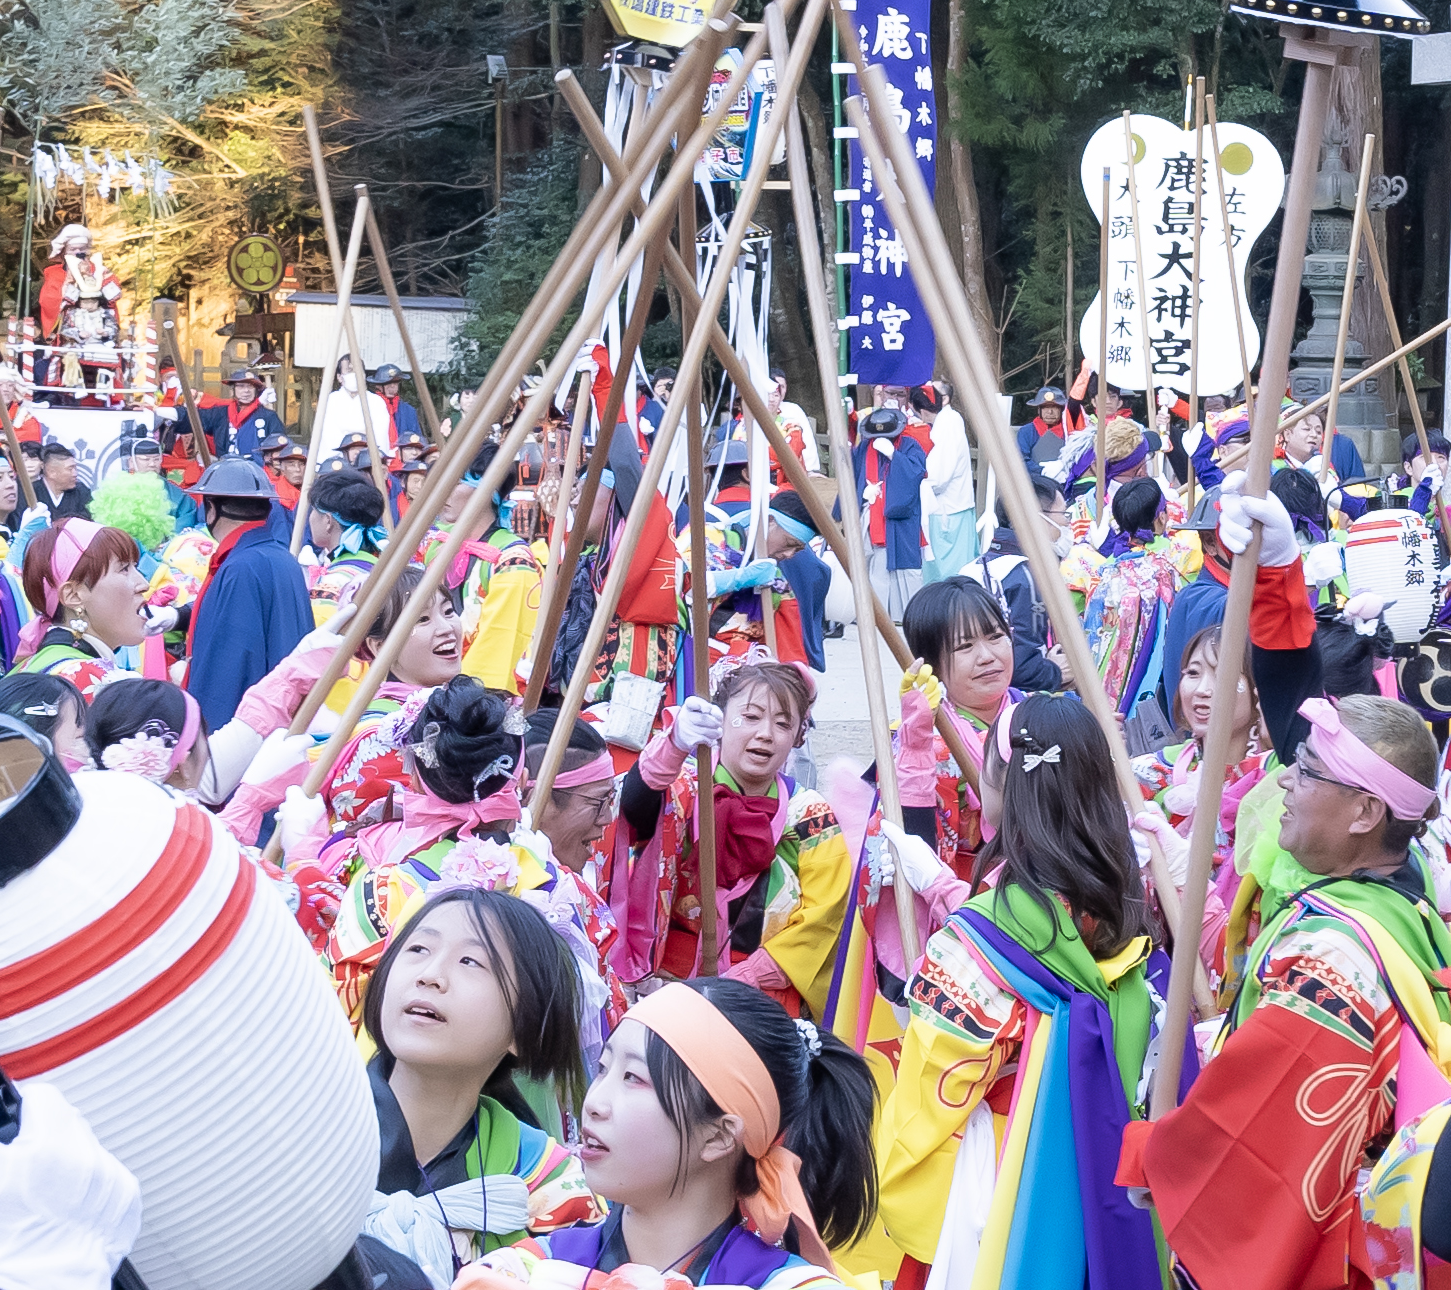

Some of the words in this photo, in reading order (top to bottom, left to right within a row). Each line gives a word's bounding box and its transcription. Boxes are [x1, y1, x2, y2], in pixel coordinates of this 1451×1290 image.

[914, 32, 934, 161] 下幡木郷
[1107, 260, 1137, 367] 下幡木郷
